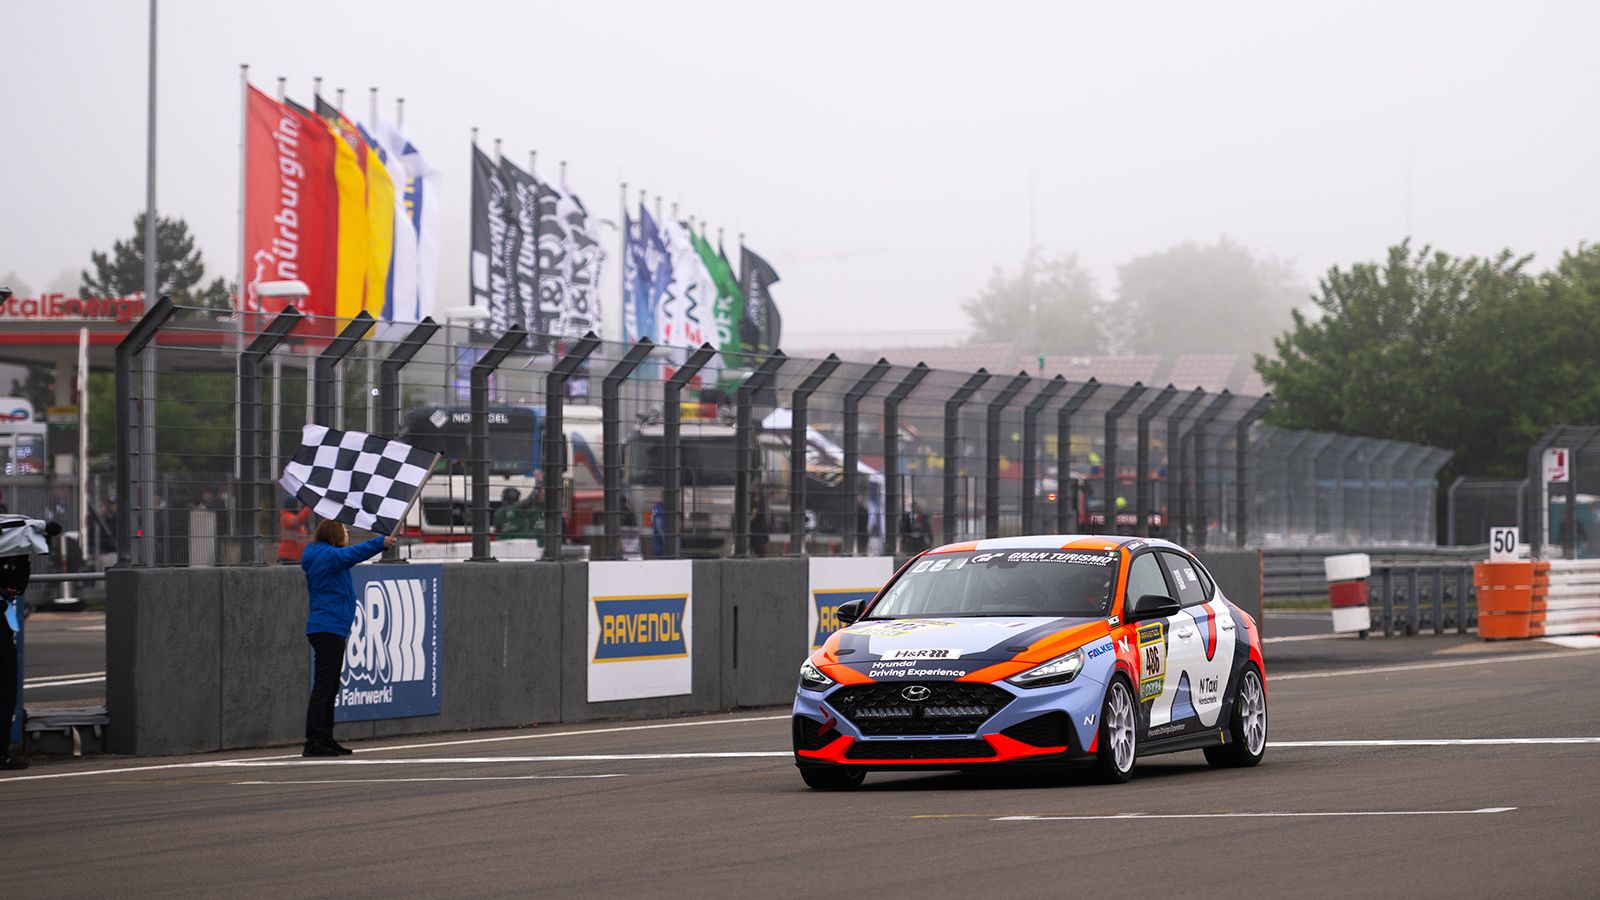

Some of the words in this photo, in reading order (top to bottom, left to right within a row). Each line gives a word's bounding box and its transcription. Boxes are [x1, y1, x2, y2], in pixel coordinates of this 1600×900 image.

[1494, 530, 1515, 553] 50
[1007, 552, 1049, 560] GRAN
[1050, 552, 1113, 564] TURISMO
[603, 612, 680, 645] RAVENOL
[871, 660, 917, 669] Hyundai
[1145, 645, 1160, 676] 486
[868, 668, 904, 678] Driving
[907, 668, 966, 677] Experience
[1205, 675, 1219, 693] Taxi
[341, 686, 393, 706] Fahrwerk!
